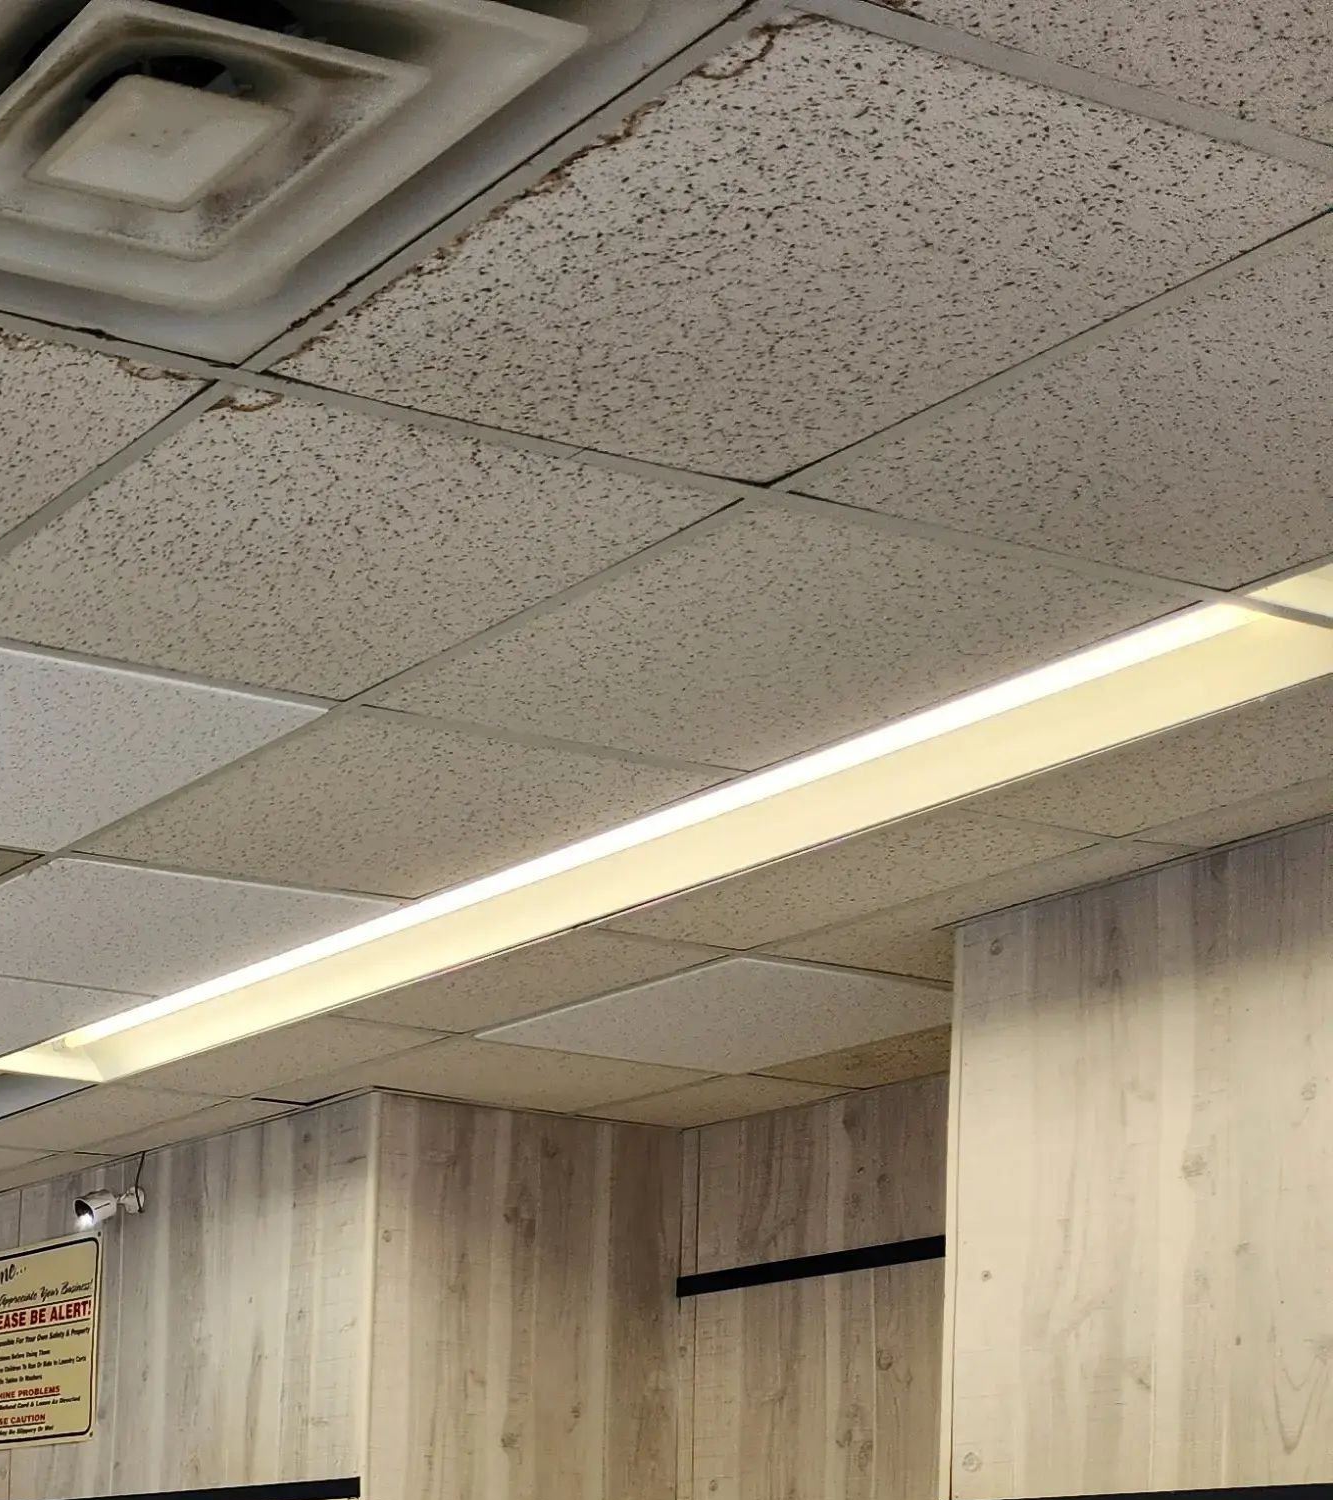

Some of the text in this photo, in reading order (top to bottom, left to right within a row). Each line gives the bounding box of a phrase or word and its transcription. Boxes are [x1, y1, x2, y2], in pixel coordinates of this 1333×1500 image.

[40, 1286, 59, 1302] Your
[30, 1307, 46, 1325] BE
[50, 1300, 92, 1321] ALERT!
[18, 1385, 60, 1397] PROBLEMS
[10, 1413, 46, 1425] CAUTION
